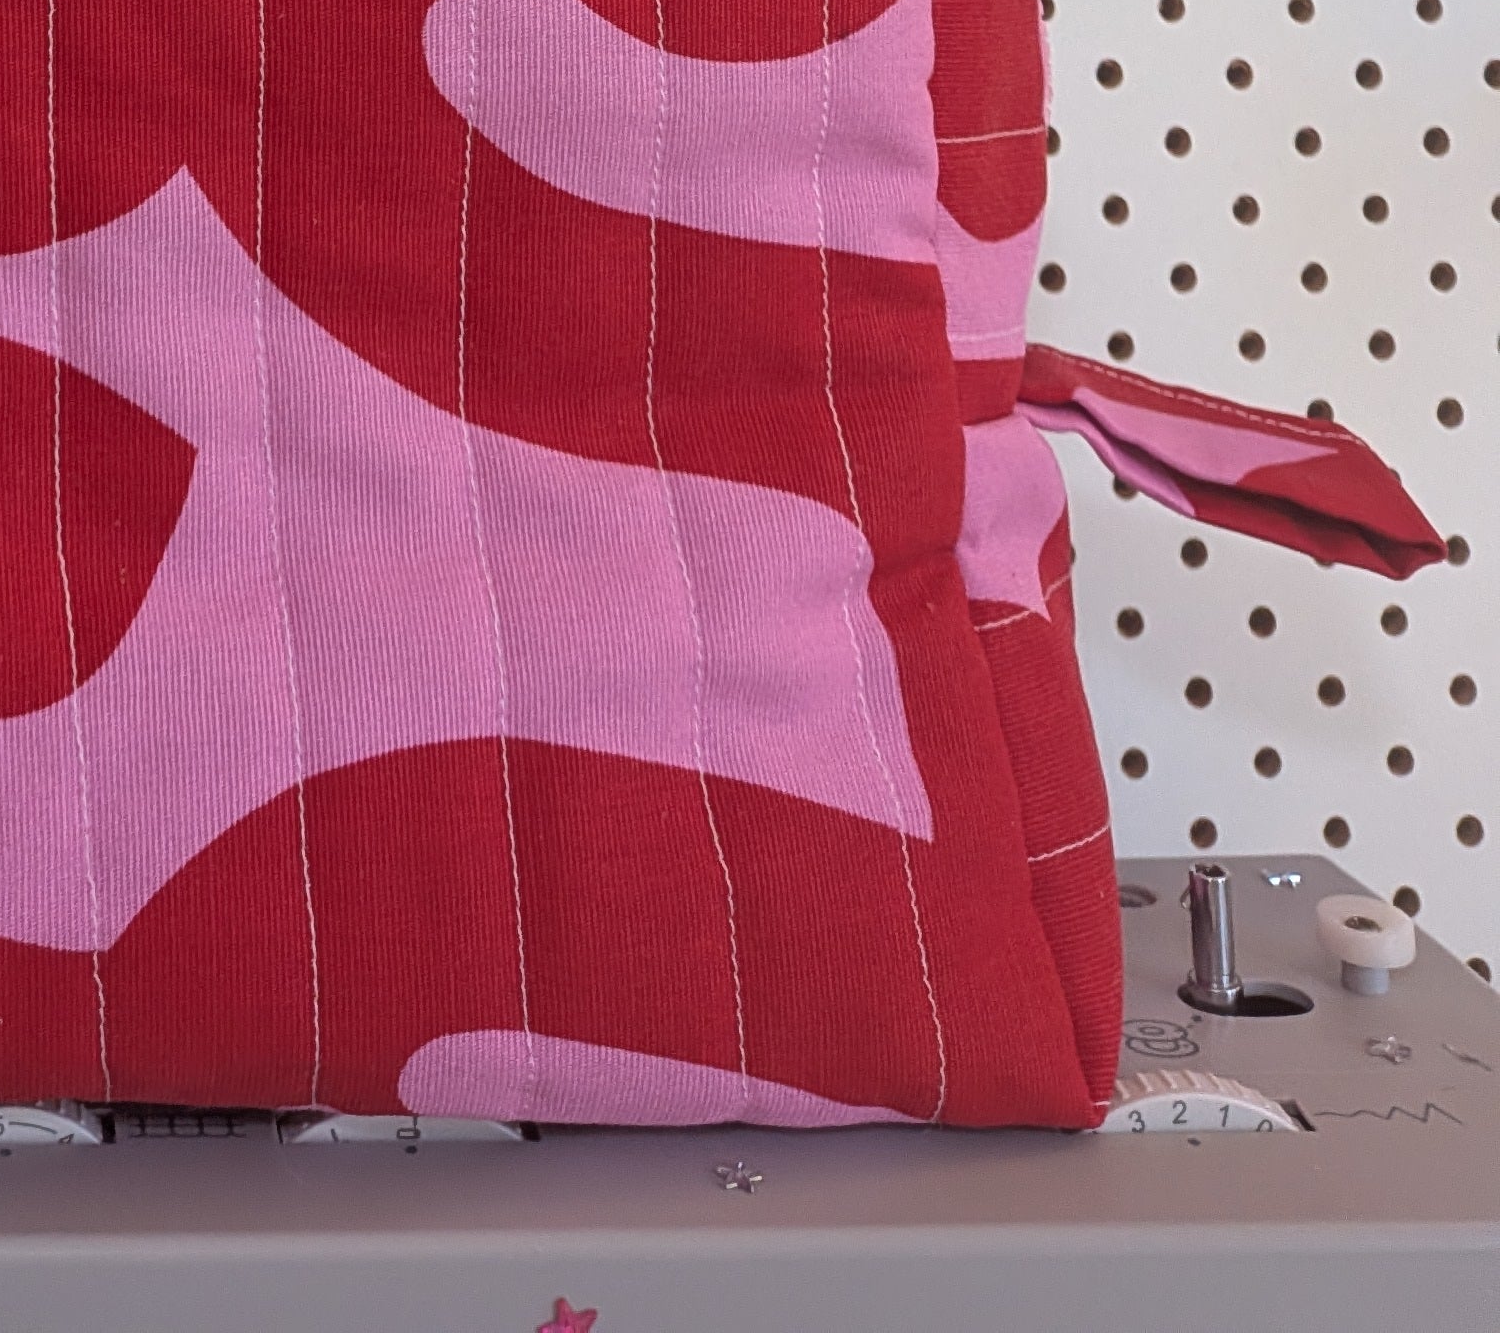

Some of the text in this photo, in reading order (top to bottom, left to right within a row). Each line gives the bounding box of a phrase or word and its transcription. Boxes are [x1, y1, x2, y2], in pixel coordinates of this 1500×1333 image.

[1128, 1110, 1145, 1133] 3
[1172, 1100, 1188, 1124] 2
[1219, 1105, 1230, 1127] 1
